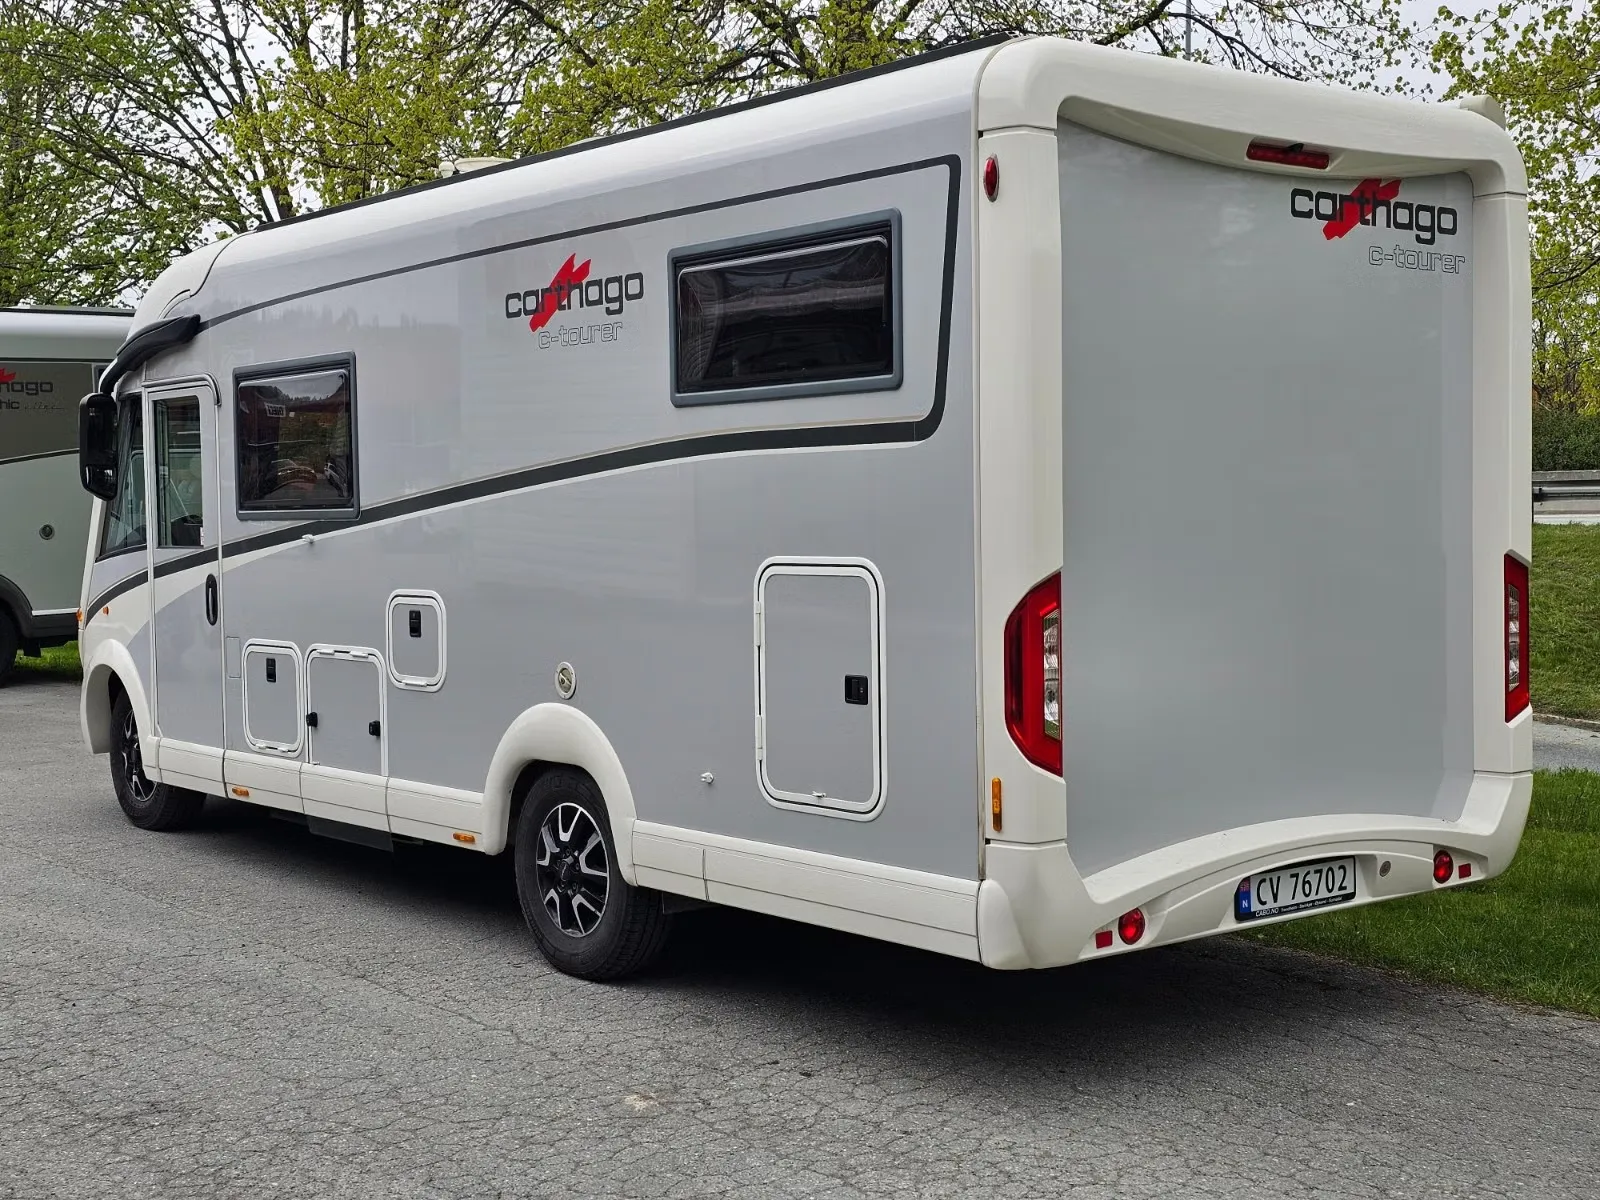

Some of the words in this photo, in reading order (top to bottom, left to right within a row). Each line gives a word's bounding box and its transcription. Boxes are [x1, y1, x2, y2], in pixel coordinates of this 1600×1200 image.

[1290, 187, 1458, 245] carthago
[1369, 244, 1466, 274] c-tourer
[505, 272, 644, 319] carthago
[538, 321, 623, 349] c-tourer
[1256, 876, 1281, 906] CV
[1289, 864, 1348, 901] 76702
[1242, 900, 1248, 908] N
